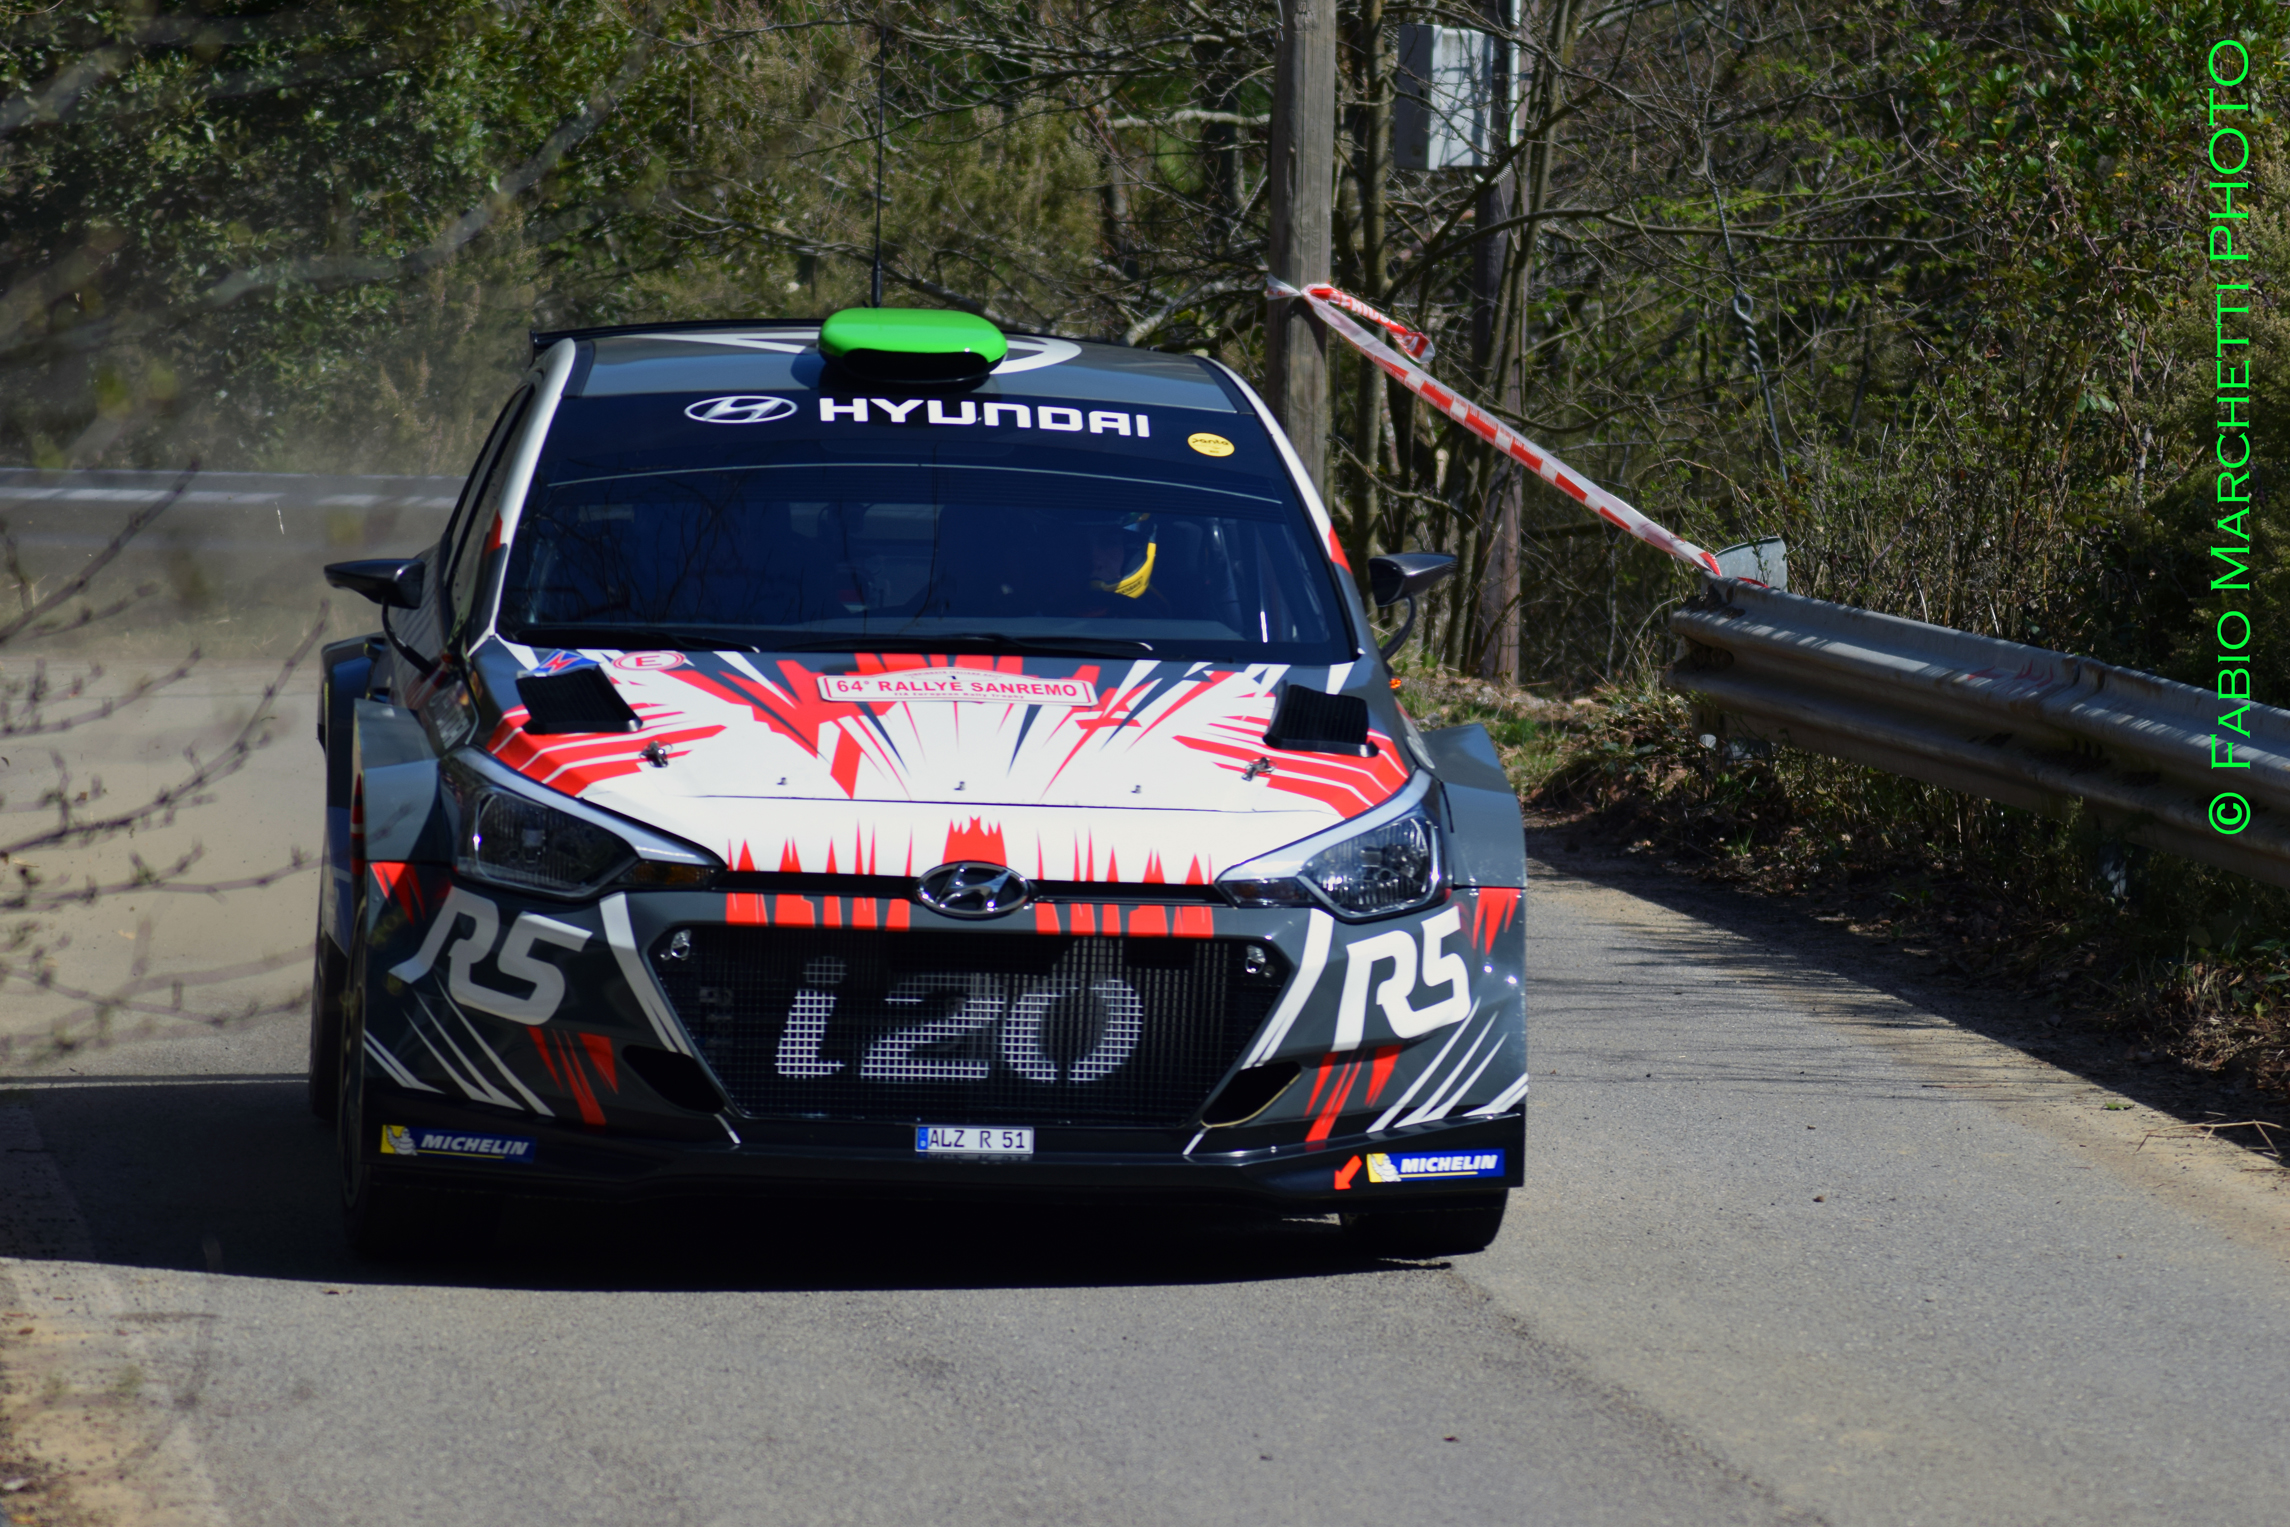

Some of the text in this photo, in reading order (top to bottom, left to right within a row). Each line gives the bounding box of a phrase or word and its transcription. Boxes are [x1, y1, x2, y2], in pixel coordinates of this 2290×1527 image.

[819, 397, 1150, 437] HYUNDAI
[635, 655, 662, 667] E
[878, 680, 964, 692] RALLYE
[971, 682, 1078, 697] SANREMO
[388, 885, 593, 1026] R5
[1330, 905, 1472, 1052] R5
[421, 1134, 529, 1155] MICHELIN
[929, 1129, 1025, 1149] ALZ R 51
[1400, 1154, 1498, 1173] MICHELIN
